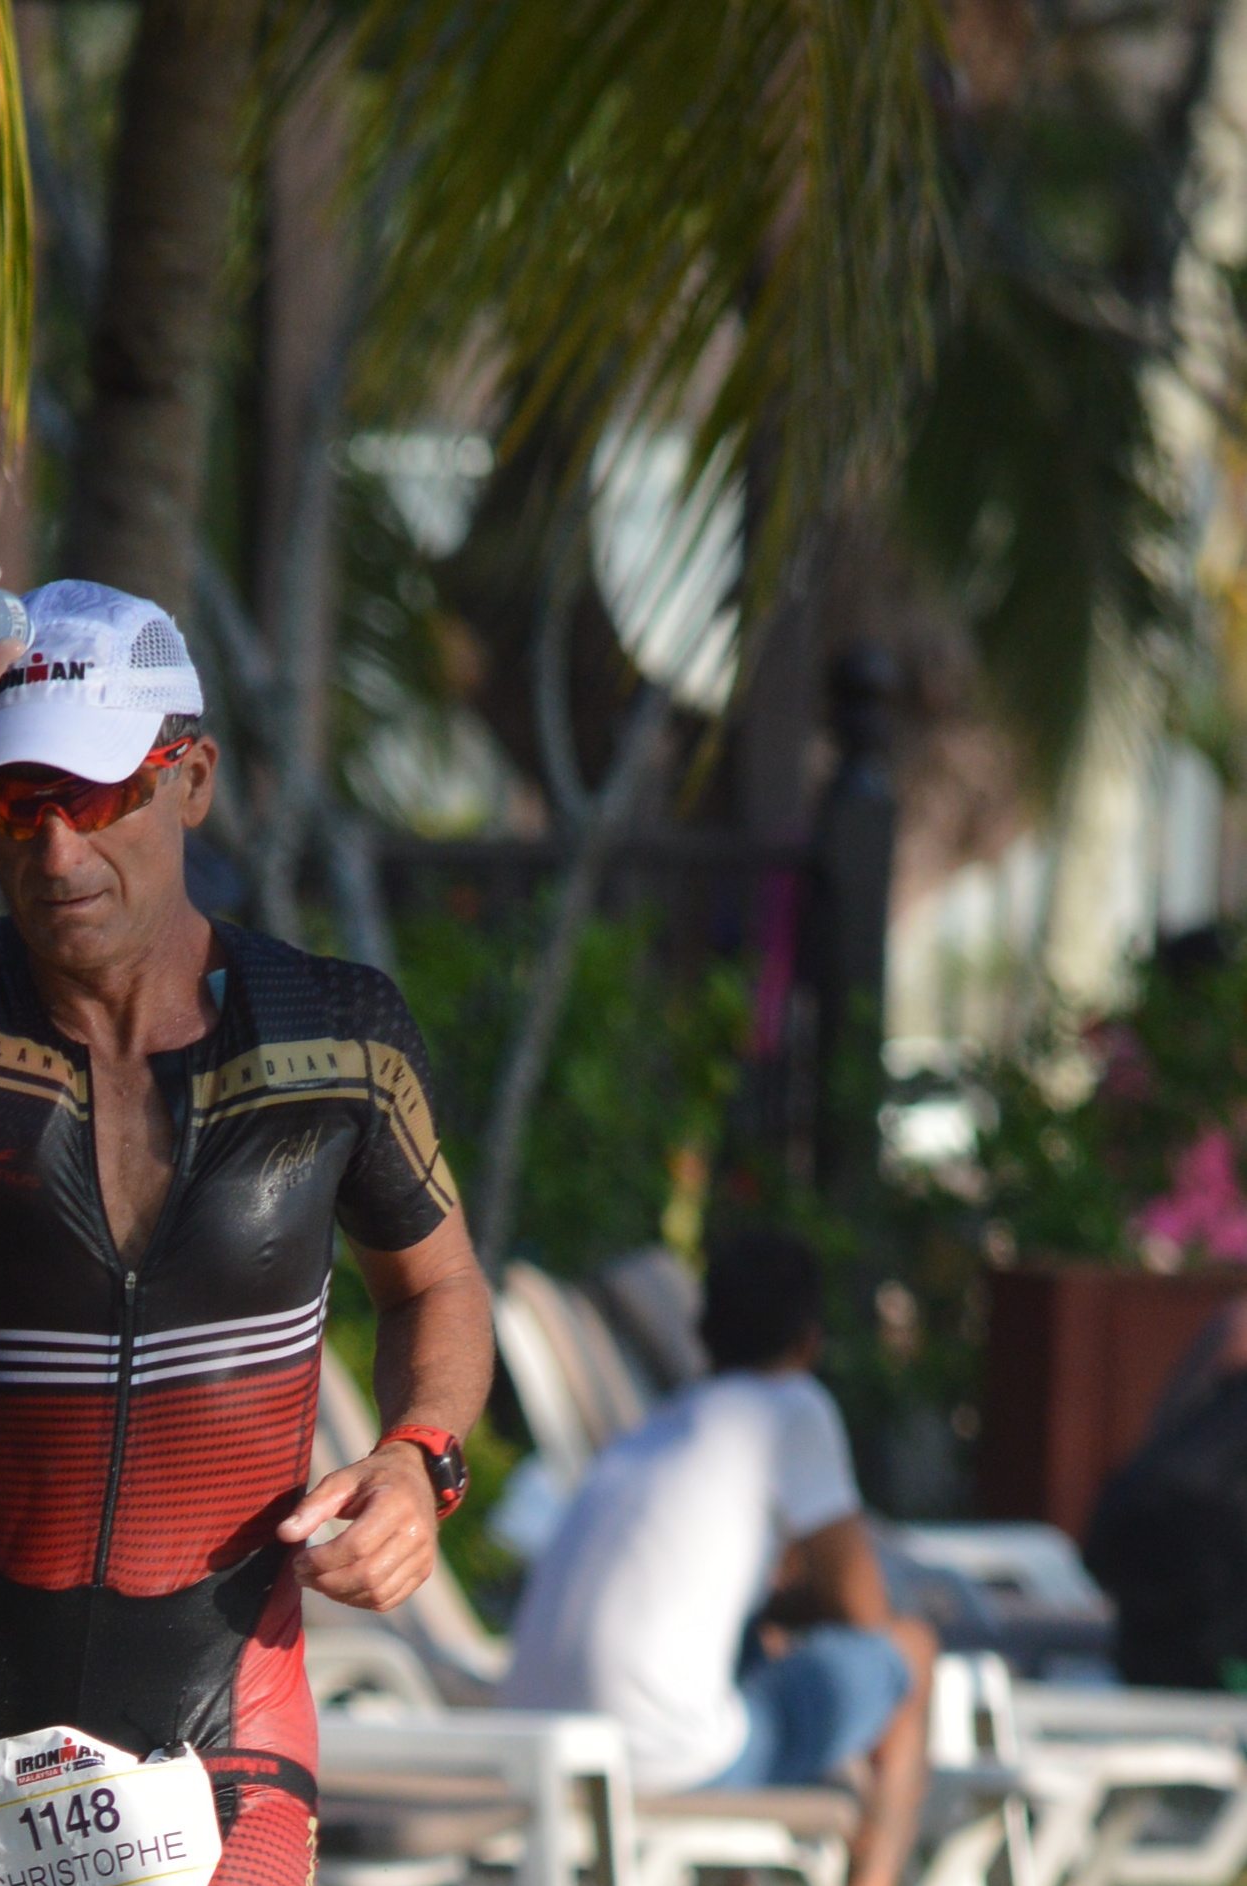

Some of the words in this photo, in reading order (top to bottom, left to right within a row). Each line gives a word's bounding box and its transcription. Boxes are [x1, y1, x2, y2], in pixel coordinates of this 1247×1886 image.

[221, 1053, 339, 1093] INDIAN
[18, 1768, 61, 1785] MALAYSIA
[18, 1787, 121, 1852] 1148
